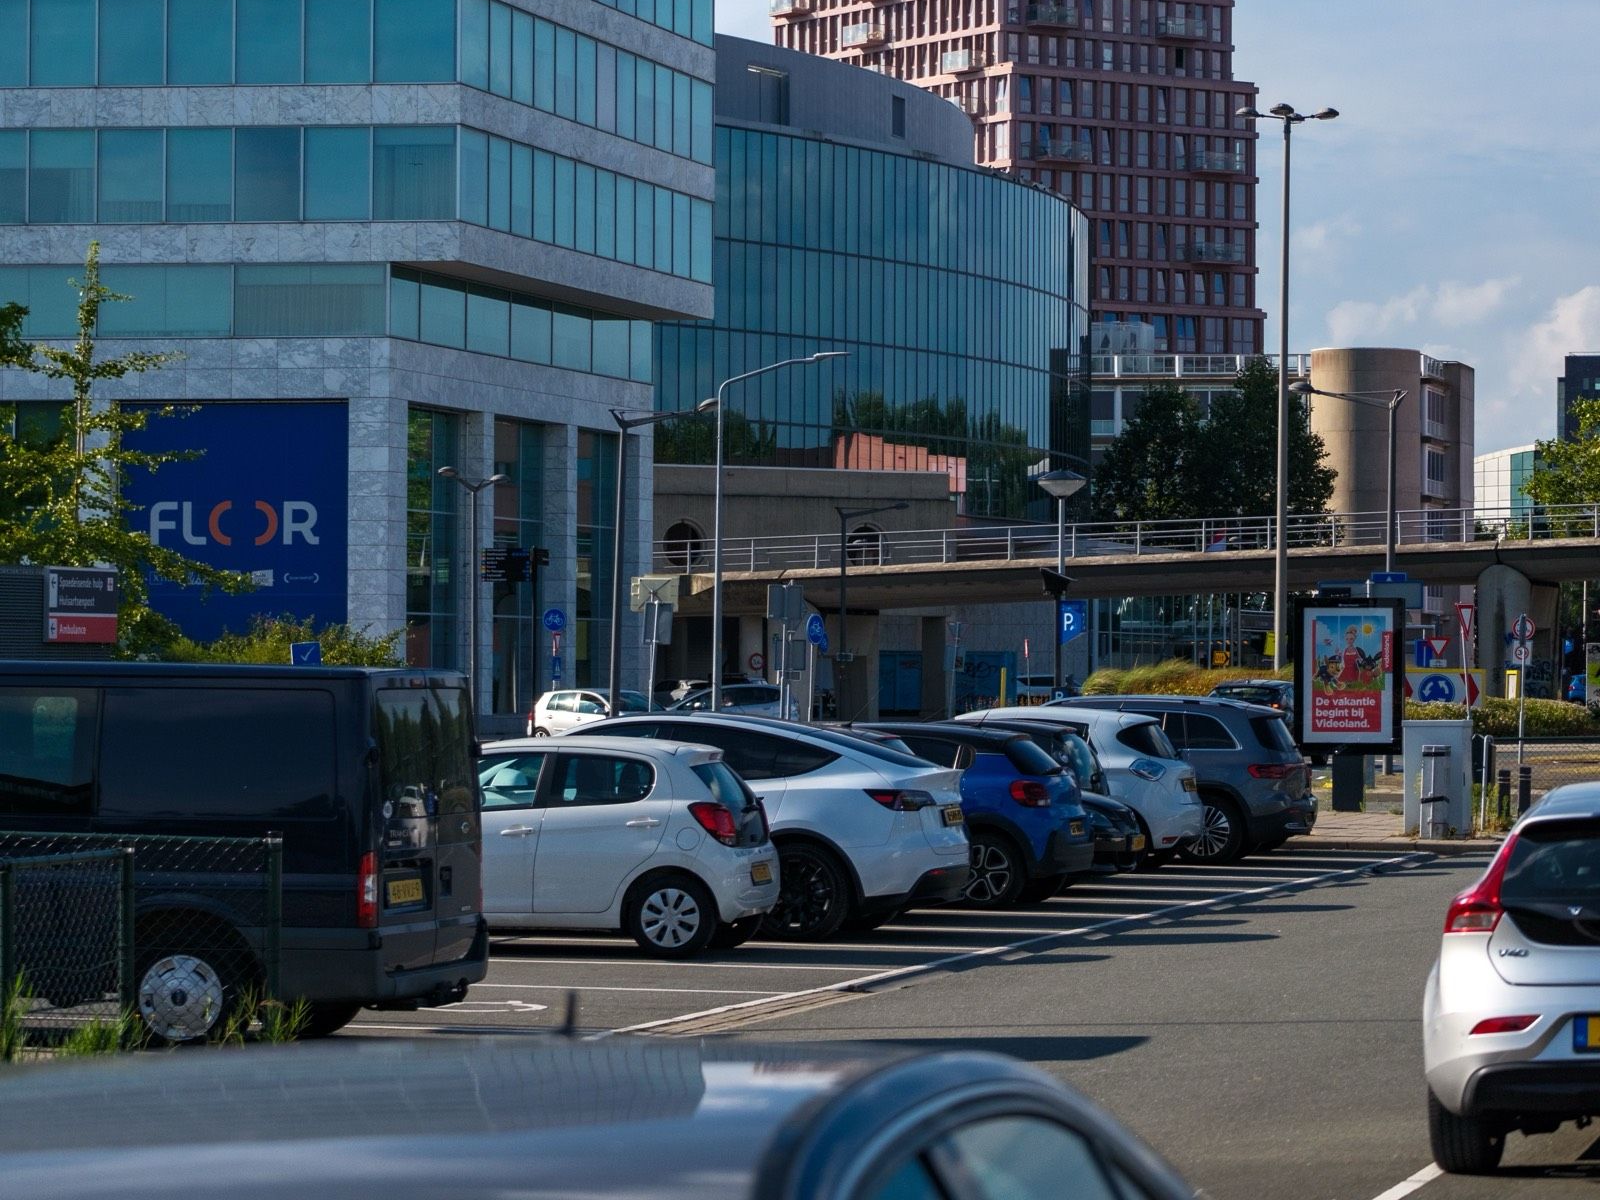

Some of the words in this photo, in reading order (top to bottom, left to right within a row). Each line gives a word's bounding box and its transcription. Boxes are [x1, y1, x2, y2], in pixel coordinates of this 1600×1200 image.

[59, 576, 92, 589] Spoedeisende
[92, 577, 104, 591] hulp
[59, 595, 95, 609] Huisartsenpost
[59, 623, 87, 635] Ambulance
[1315, 697, 1330, 706] De
[1332, 696, 1376, 706] vakantie
[1315, 707, 1349, 719] begint
[1351, 707, 1365, 719] bij
[1315, 719, 1371, 728] Videoland.
[1499, 949, 1530, 958] V40
